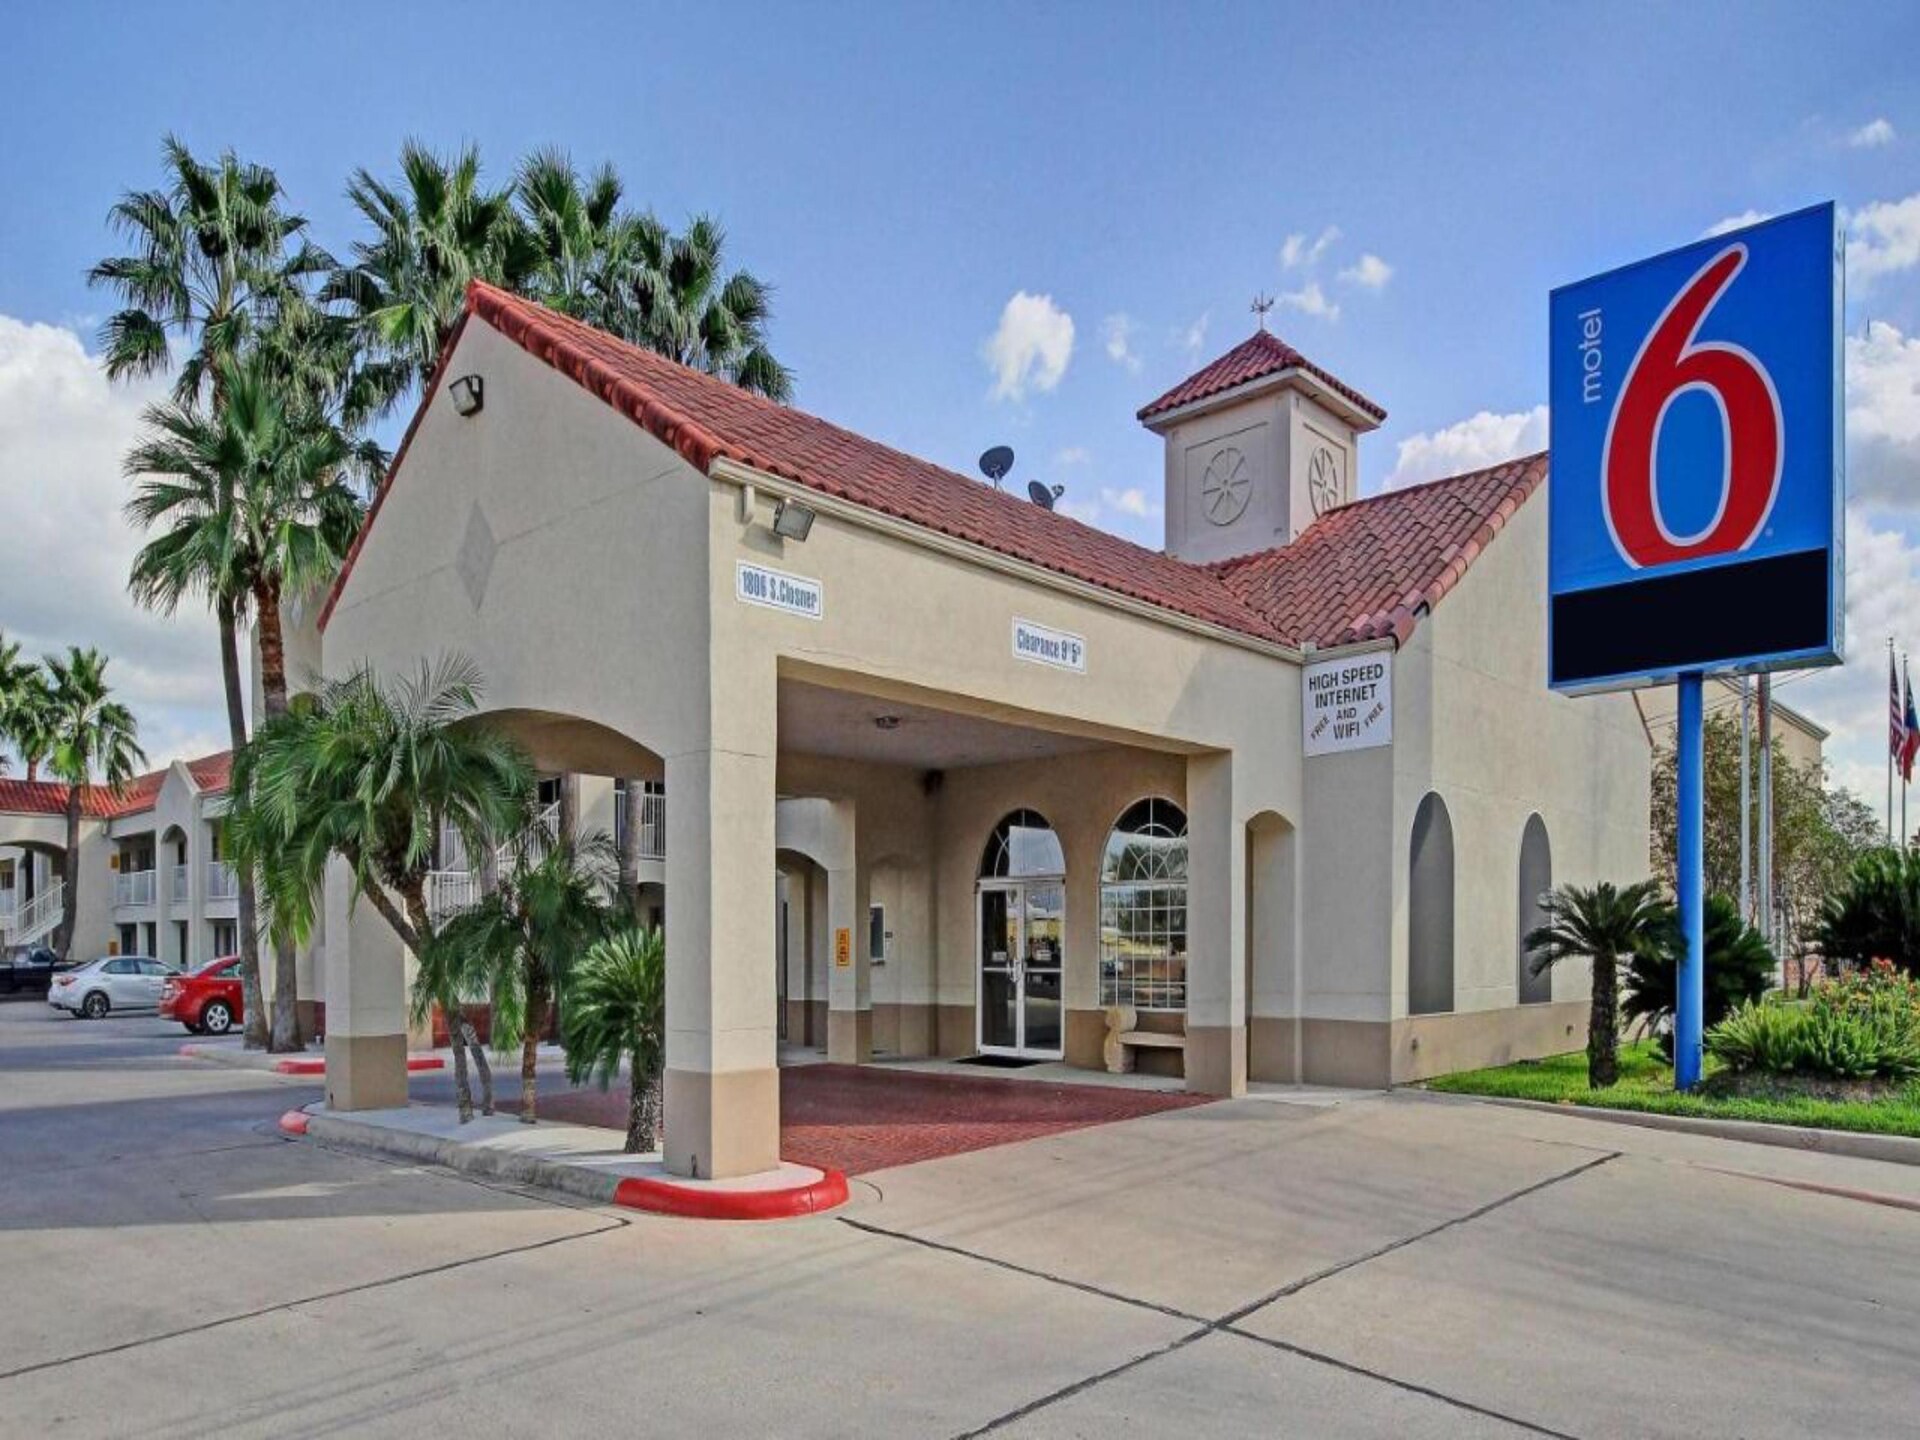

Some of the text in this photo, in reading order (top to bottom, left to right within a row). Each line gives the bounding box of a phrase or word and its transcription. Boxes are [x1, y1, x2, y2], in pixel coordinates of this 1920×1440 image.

[1578, 308, 1602, 403] motel
[1600, 241, 1785, 570] 6
[742, 570, 767, 598] 1806
[1017, 628, 1059, 659] Clearance
[1309, 663, 1384, 691] HIGH SPEED
[1315, 684, 1377, 708] INTERNET
[1310, 713, 1330, 740] FREE
[1336, 707, 1357, 720] AND
[1364, 701, 1384, 728] FREE
[1333, 721, 1360, 740] WIFI
